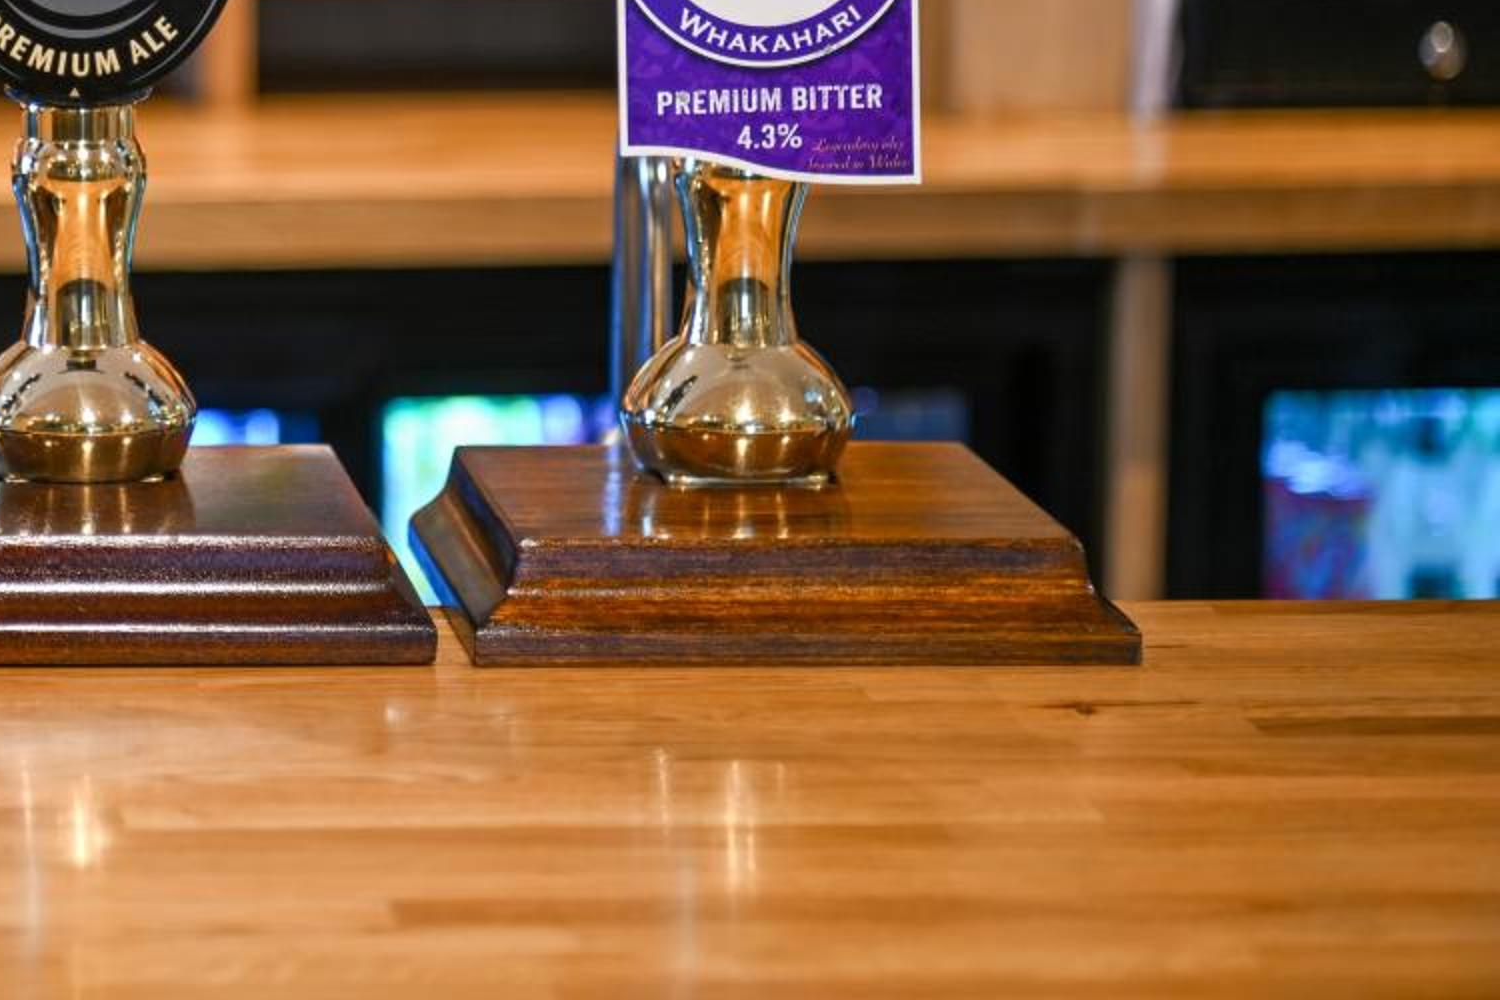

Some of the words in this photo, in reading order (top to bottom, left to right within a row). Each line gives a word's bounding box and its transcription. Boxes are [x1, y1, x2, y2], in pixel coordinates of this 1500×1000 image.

[130, 15, 179, 66] ALE
[680, 4, 862, 53] WHAKAHARI
[656, 87, 781, 116] PREMIUM
[792, 83, 883, 111] BITTER
[737, 124, 802, 149] 4.3%
